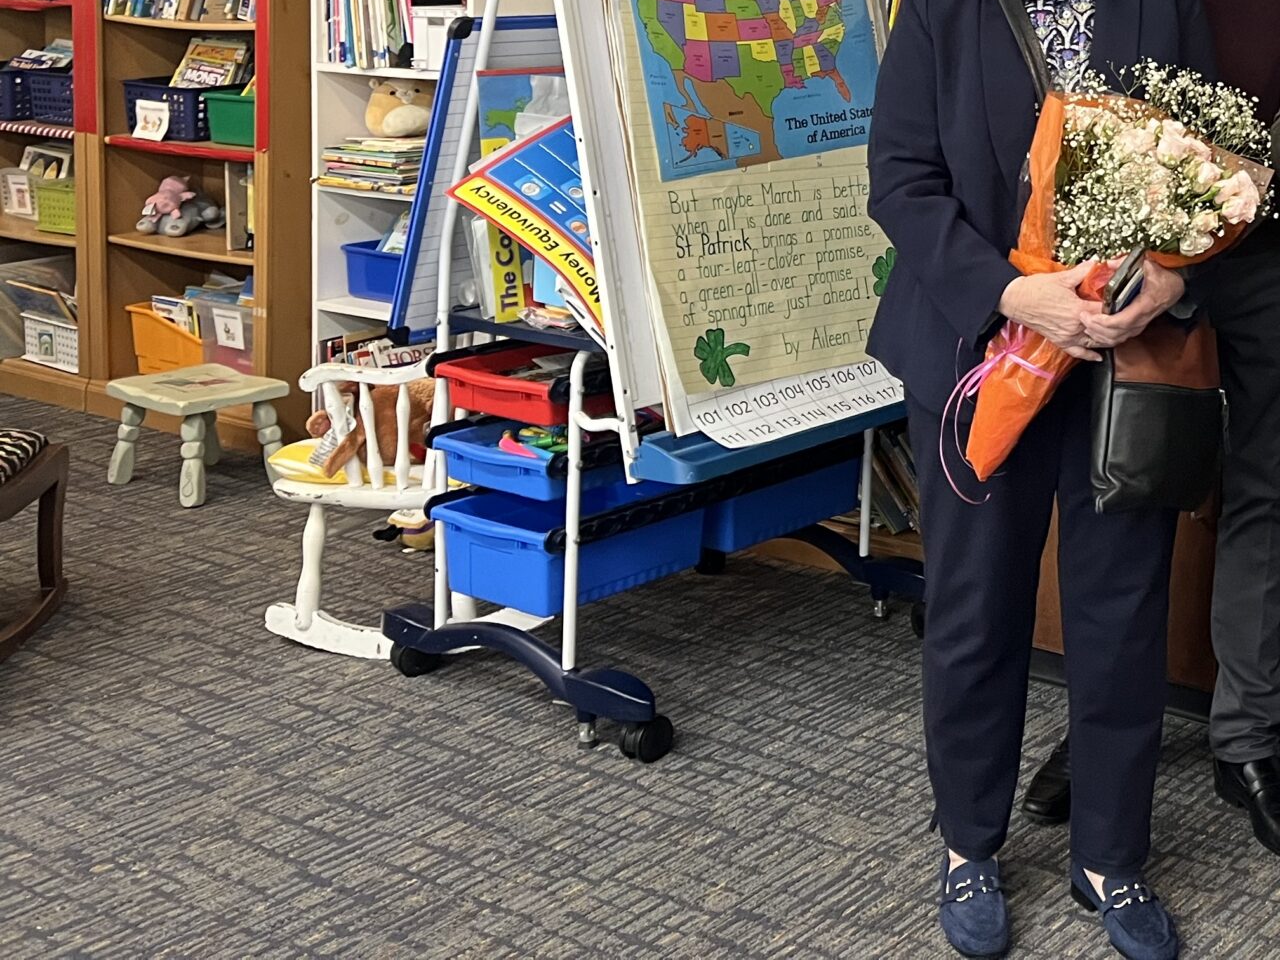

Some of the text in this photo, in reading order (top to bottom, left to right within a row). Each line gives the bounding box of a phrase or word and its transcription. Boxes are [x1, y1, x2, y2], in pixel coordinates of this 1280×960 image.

[183, 68, 225, 86] MONEY
[785, 106, 874, 131] The United State
[807, 125, 866, 144] of America
[667, 176, 870, 218] But maybe March is bette
[469, 184, 560, 252] Equivalency
[672, 212, 709, 237] when
[717, 210, 736, 233] all
[746, 217, 756, 230] is
[764, 205, 792, 227] done
[801, 201, 823, 224] and
[701, 229, 752, 257] Patrick
[761, 227, 798, 254] brings
[806, 231, 813, 244] a
[823, 223, 875, 250] promise,
[678, 268, 686, 281] a
[816, 247, 869, 271] promise,
[500, 271, 519, 314] The
[679, 291, 688, 304] a
[808, 267, 852, 292] promise
[683, 302, 696, 327] of
[784, 290, 812, 319] just
[387, 346, 435, 366] HORS
[782, 333, 800, 361] by
[811, 326, 850, 351] Aileen
[696, 360, 878, 427] 101 102 103 104 105 106 107
[720, 430, 747, 445] 111
[748, 423, 775, 439] 112
[775, 416, 802, 431] 113
[800, 408, 826, 423] 114
[826, 401, 852, 415] 115
[852, 394, 877, 408] 116
[876, 386, 897, 400] 117
